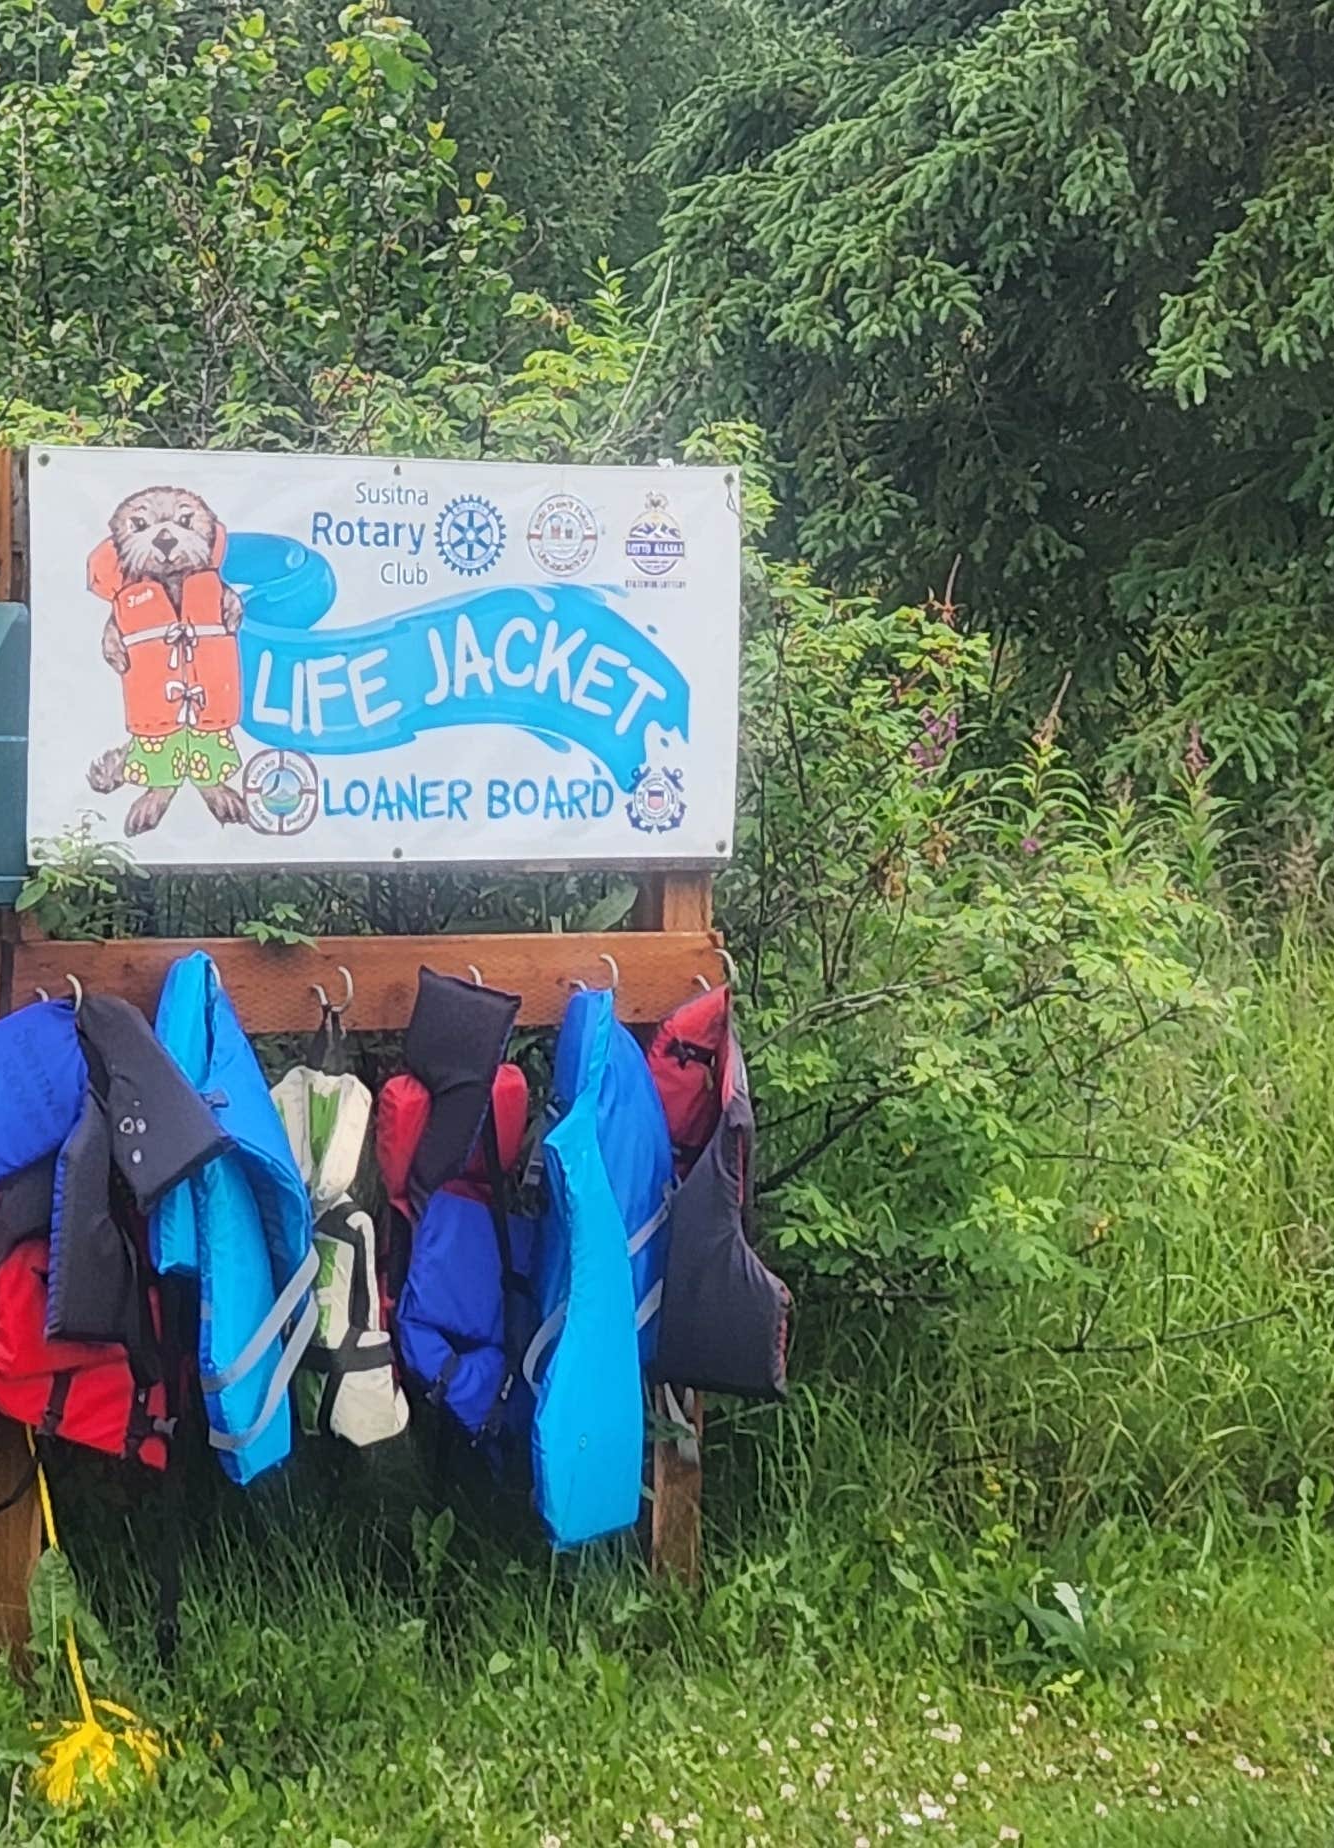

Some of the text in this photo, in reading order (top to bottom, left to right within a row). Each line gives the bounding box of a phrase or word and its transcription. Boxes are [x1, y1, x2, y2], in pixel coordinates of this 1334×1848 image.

[355, 481, 428, 506] Susitna
[311, 511, 426, 556] Rotary
[380, 561, 428, 585] Club
[252, 613, 668, 737] LIFE JACKET
[322, 774, 473, 822] LOANER
[486, 774, 615, 821] BOARD
